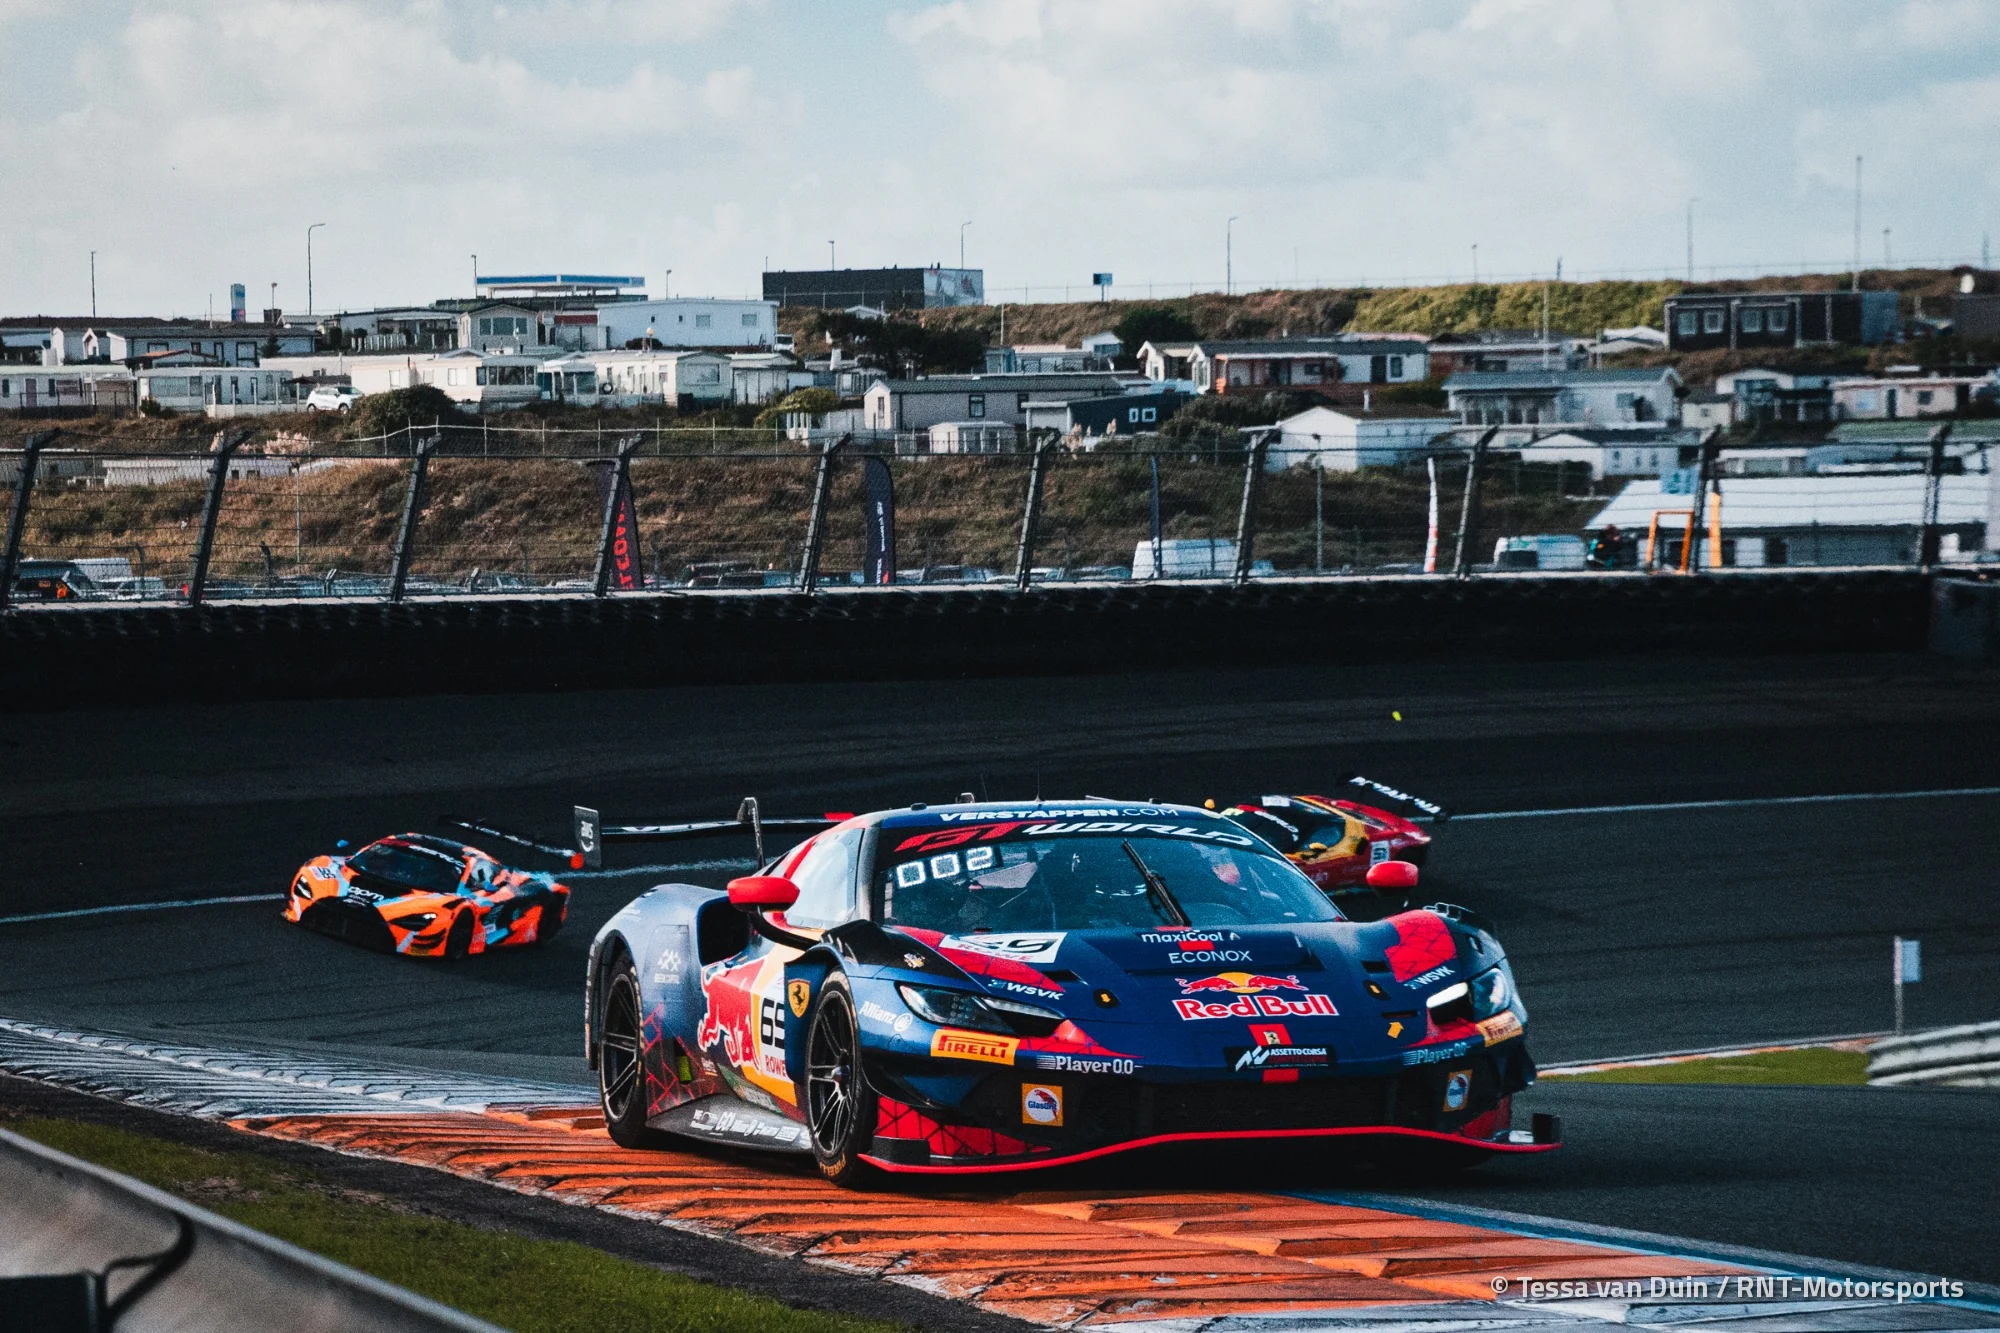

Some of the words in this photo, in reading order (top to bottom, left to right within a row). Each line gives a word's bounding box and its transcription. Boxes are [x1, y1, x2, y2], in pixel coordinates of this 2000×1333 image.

[939, 808, 1178, 822] VERSTAPPEN.COM
[894, 819, 1057, 853] GT
[896, 846, 994, 889] 002
[1141, 930, 1224, 943] maxiCool
[1168, 950, 1253, 964] ECONOX
[1416, 966, 1455, 985] WSVK
[1006, 982, 1064, 1000] WSVK
[858, 1000, 897, 1025] Allianz
[1173, 995, 1262, 1021] Red
[1252, 994, 1340, 1017] Bull
[938, 1035, 1009, 1058] PIRELLI
[1416, 1046, 1453, 1063] Player
[1055, 1055, 1111, 1074] Player
